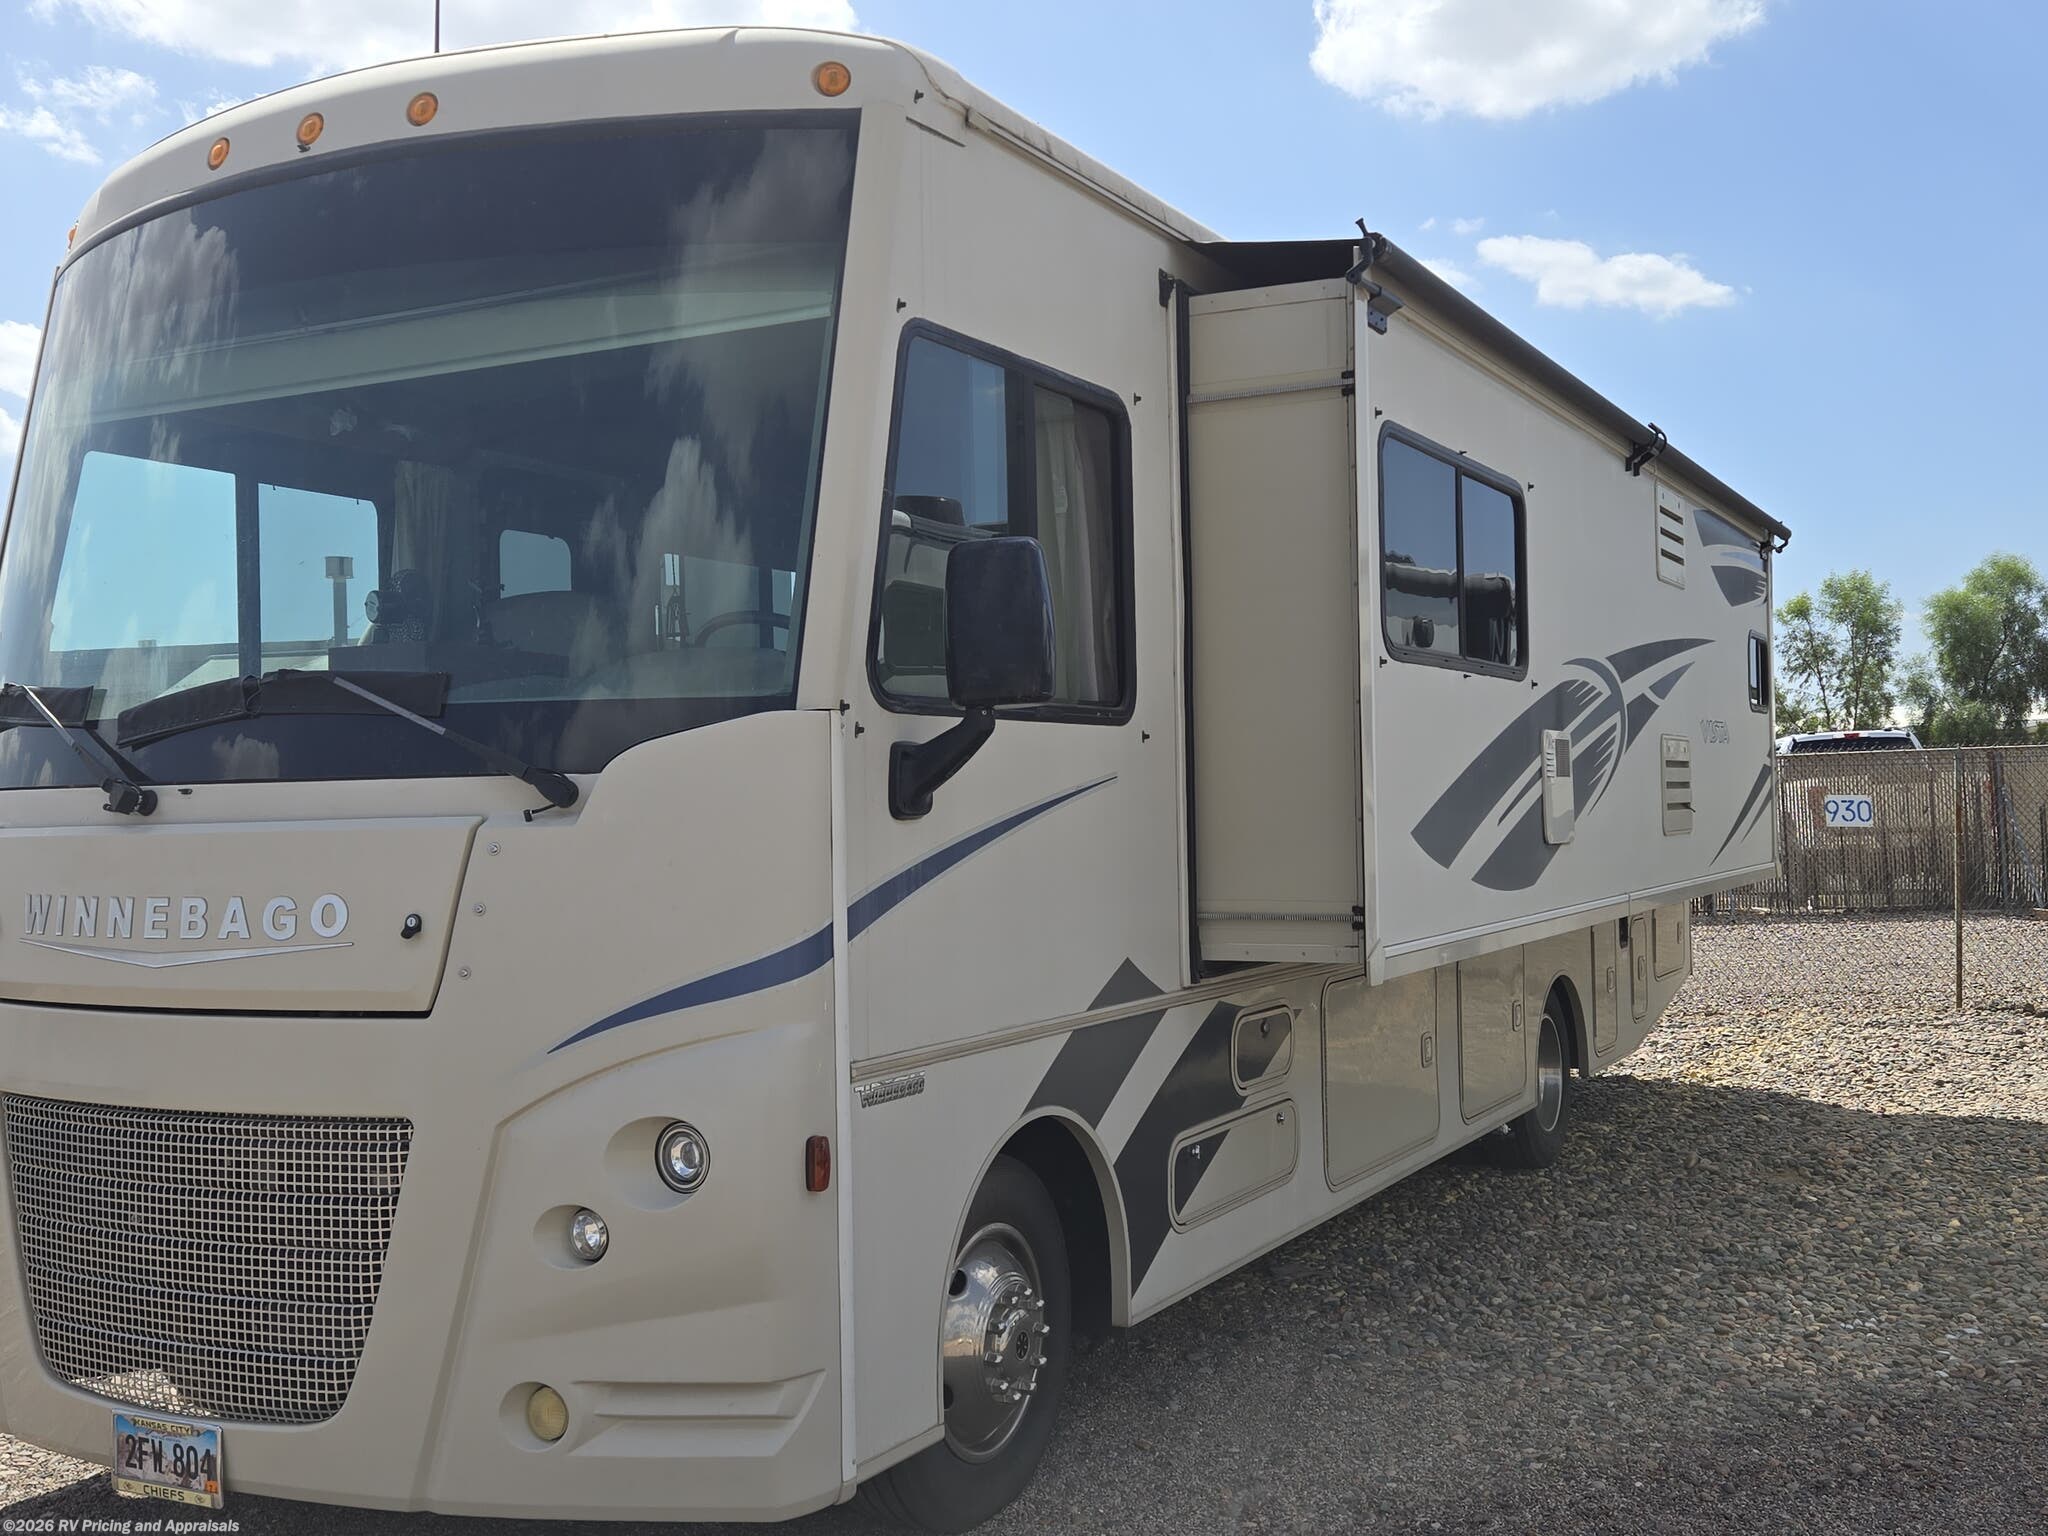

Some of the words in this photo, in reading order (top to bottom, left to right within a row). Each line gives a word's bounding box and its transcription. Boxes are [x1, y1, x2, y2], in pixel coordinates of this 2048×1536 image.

[1700, 719, 1729, 744] VISTA
[1825, 799, 1872, 823] 930
[24, 892, 350, 942] WINNEBAGO
[133, 1418, 167, 1431] KANSAS
[170, 1424, 190, 1435] CITY
[173, 1443, 212, 1481] 804
[143, 1484, 185, 1501] CHIEFS
